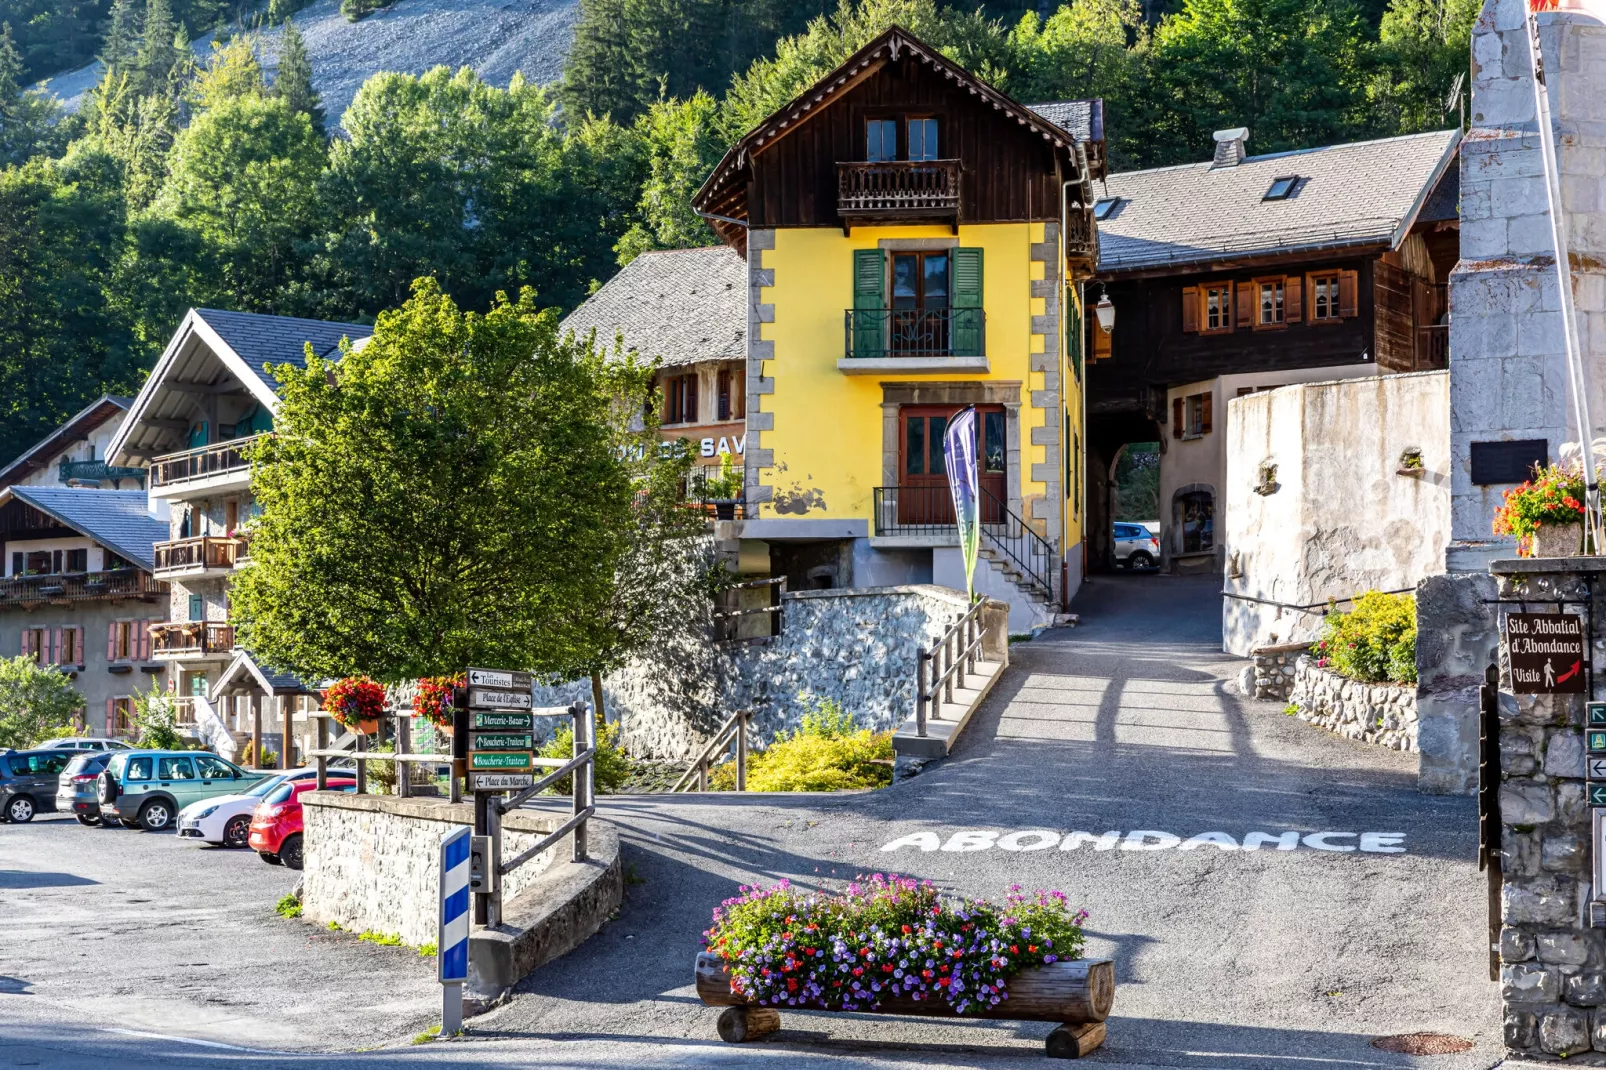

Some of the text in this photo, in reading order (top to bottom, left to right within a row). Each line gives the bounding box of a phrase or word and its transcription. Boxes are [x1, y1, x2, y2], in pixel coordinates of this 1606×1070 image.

[1509, 618, 1580, 634] Site Abbatial
[1511, 638, 1581, 654] d'Abondance
[480, 675, 511, 687] Touristes
[1513, 667, 1541, 683] Visite
[482, 692, 496, 702] Place
[496, 693, 503, 703] de
[483, 715, 525, 726] Mercerie-Bazar
[477, 755, 527, 766] Boucherie-Traiteur
[485, 775, 500, 786] Place
[500, 776, 509, 786] du
[880, 830, 1407, 853] ABONDANCE
